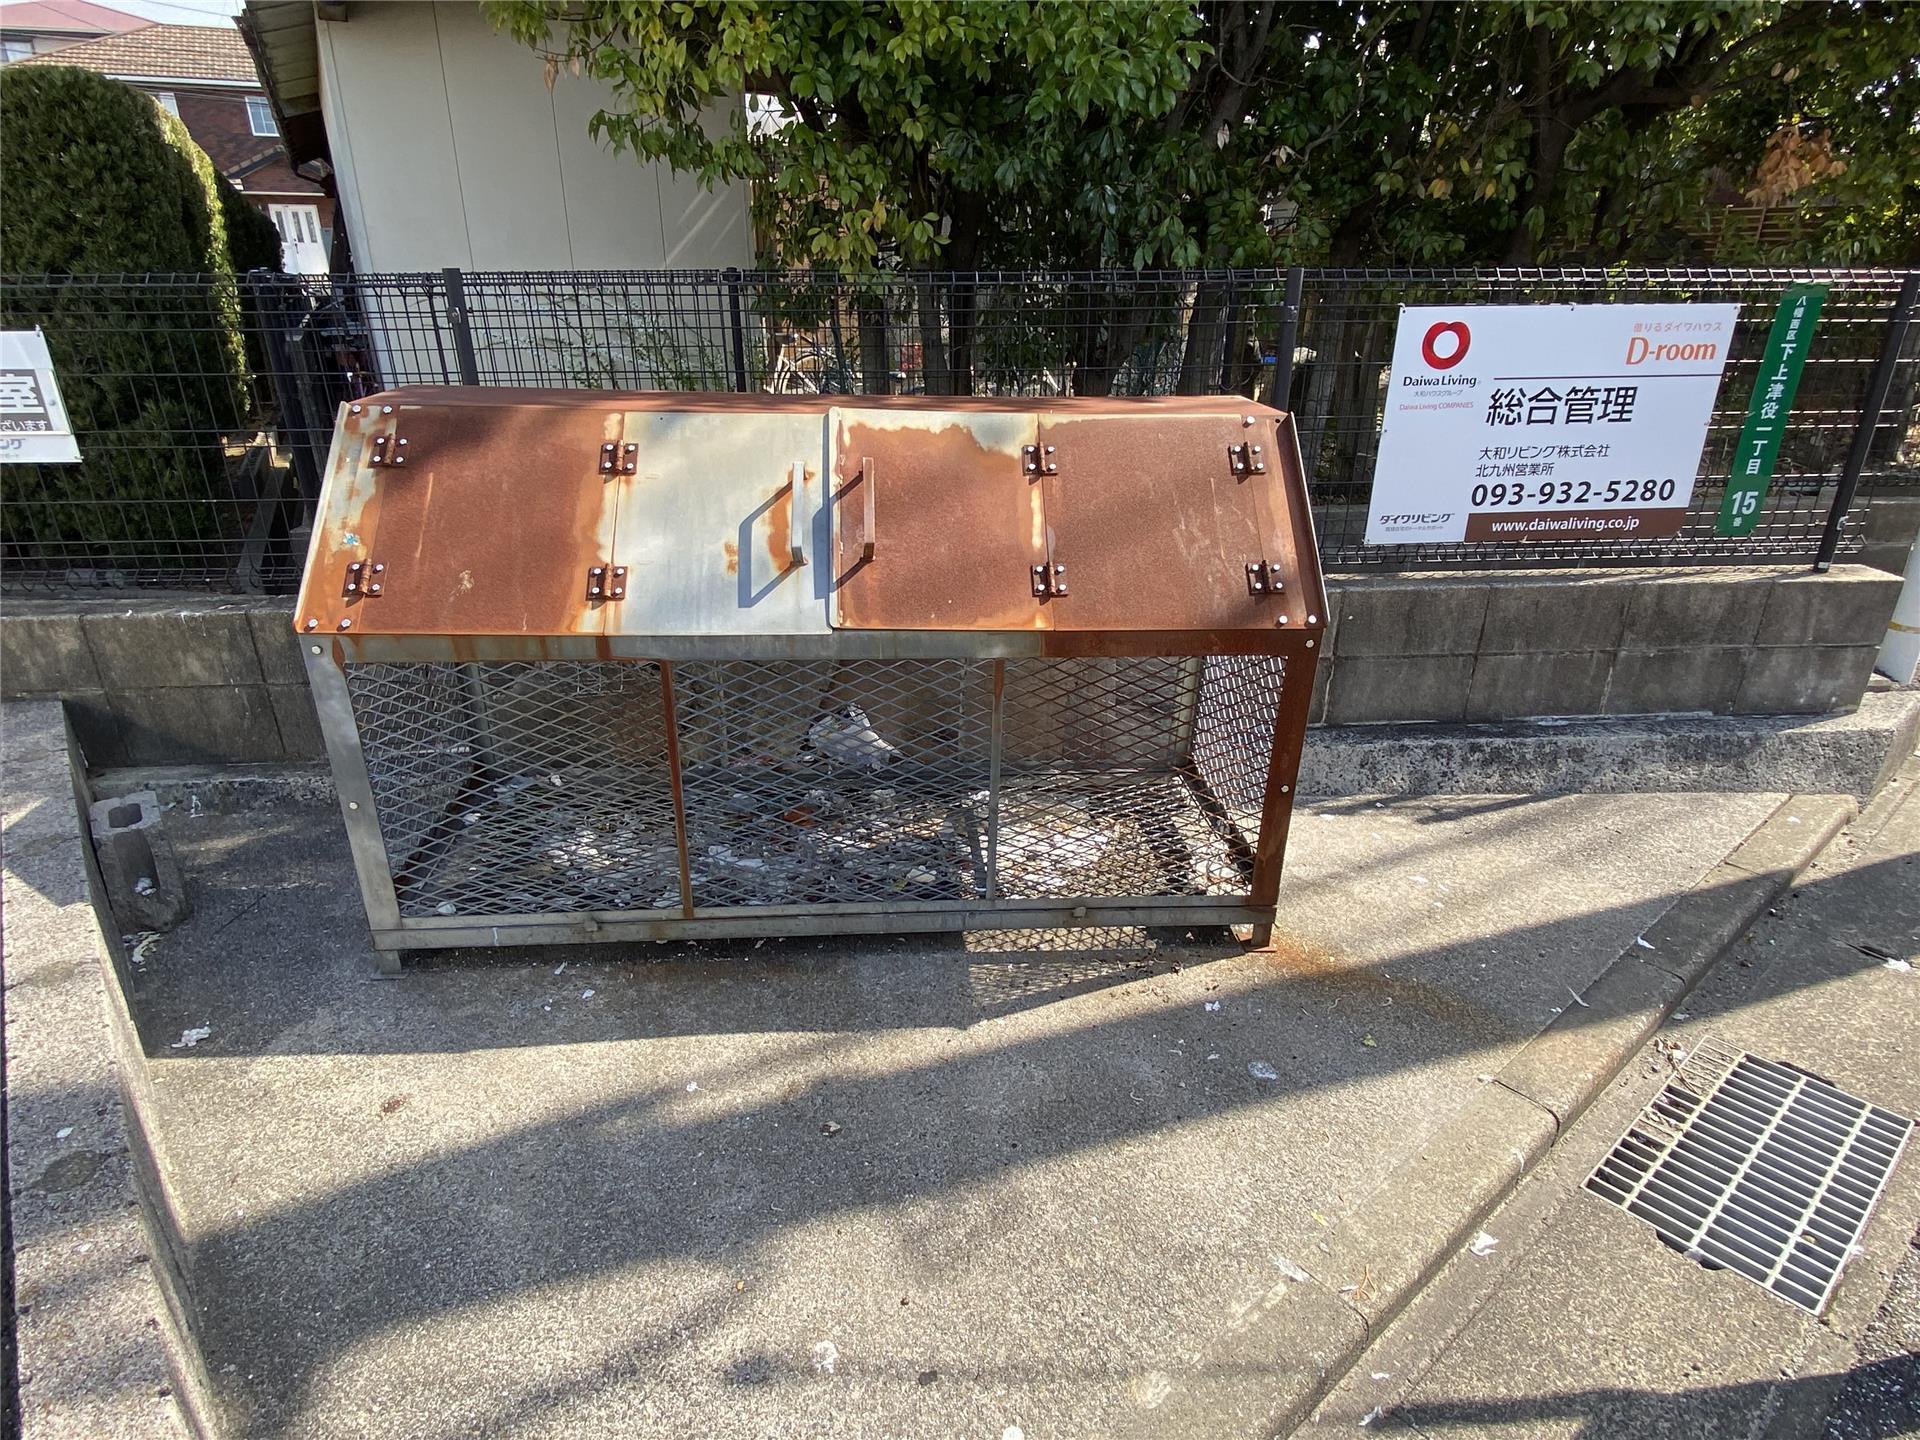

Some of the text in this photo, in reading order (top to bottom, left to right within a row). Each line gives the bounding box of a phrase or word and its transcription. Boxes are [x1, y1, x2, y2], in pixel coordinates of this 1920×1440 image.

[1626, 337, 1717, 365] D-room
[1403, 374, 1477, 388] Daiwa Living
[1487, 385, 1638, 427] 総合管理
[1478, 444, 1610, 460] 大和リビング株式会社
[1475, 462, 1555, 477] 北九州営業所
[1471, 479, 1675, 506] 093-932-5280
[1732, 491, 1759, 515] 15
[1380, 513, 1455, 525] ダイワリビング
[1492, 516, 1640, 532] www.daiwaliving.co.jp
